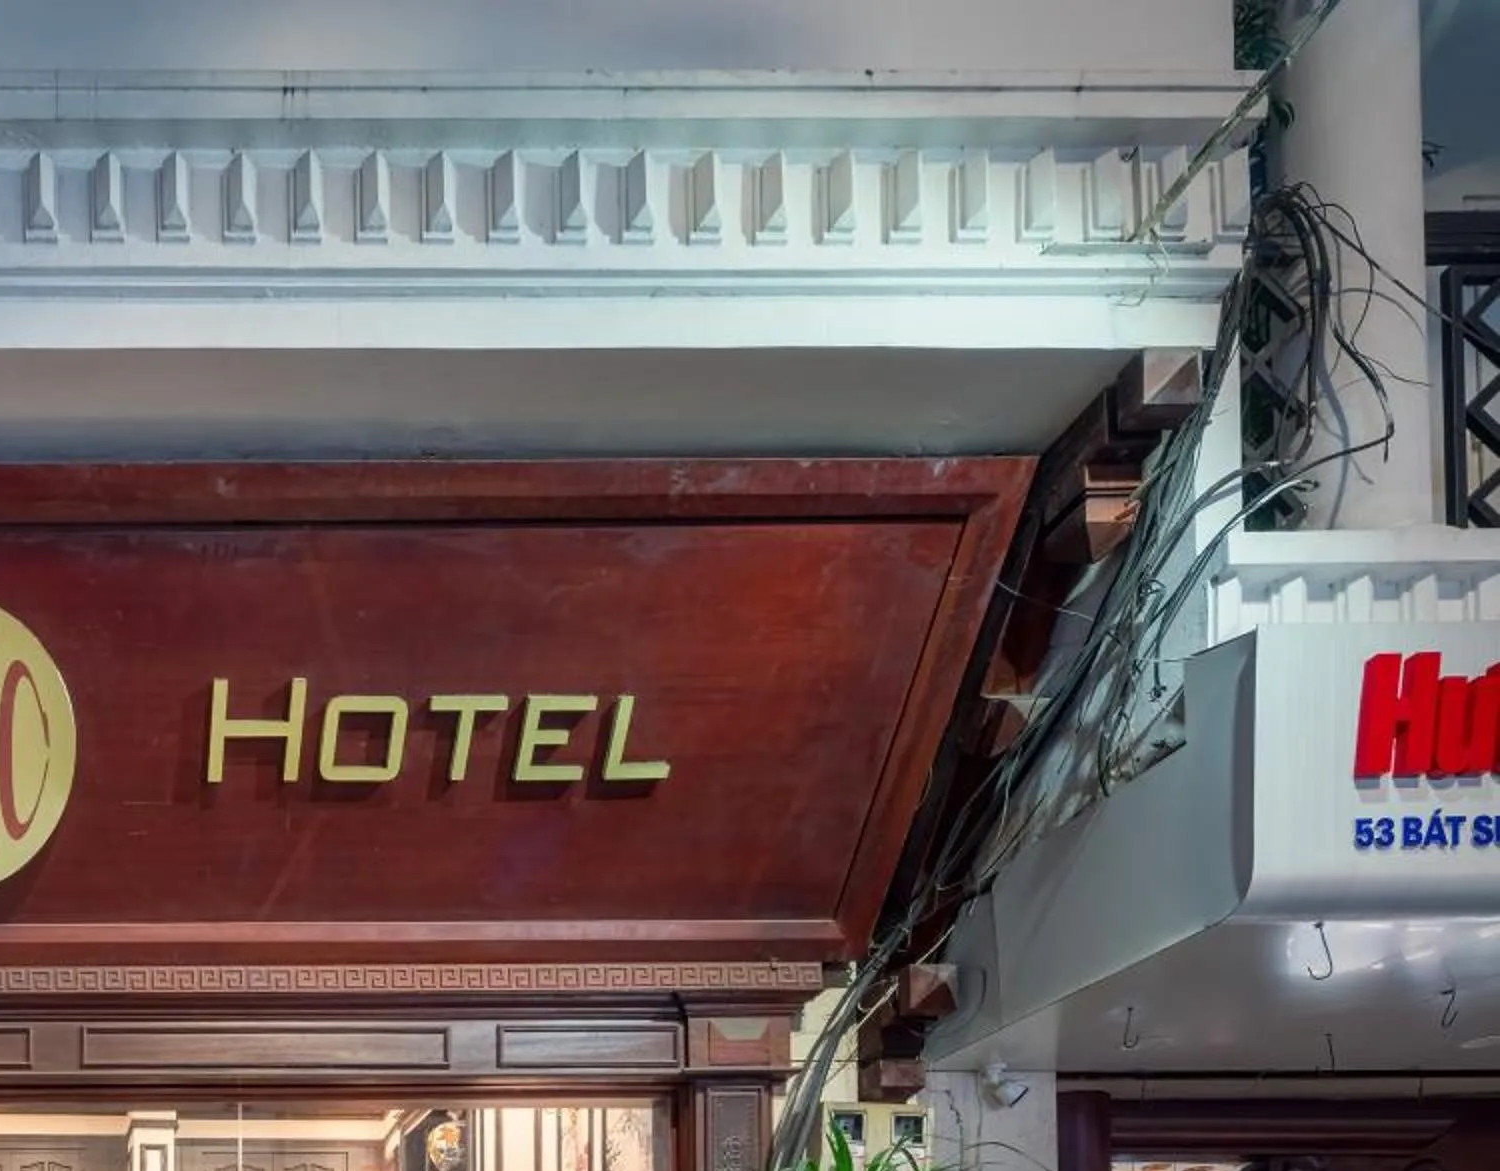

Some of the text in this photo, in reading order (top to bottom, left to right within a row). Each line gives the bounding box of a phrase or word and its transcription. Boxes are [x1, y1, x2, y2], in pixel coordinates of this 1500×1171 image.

[206, 677, 671, 783] HOTEL
[1354, 817, 1395, 847] 53
[1401, 808, 1466, 848] BÁT
